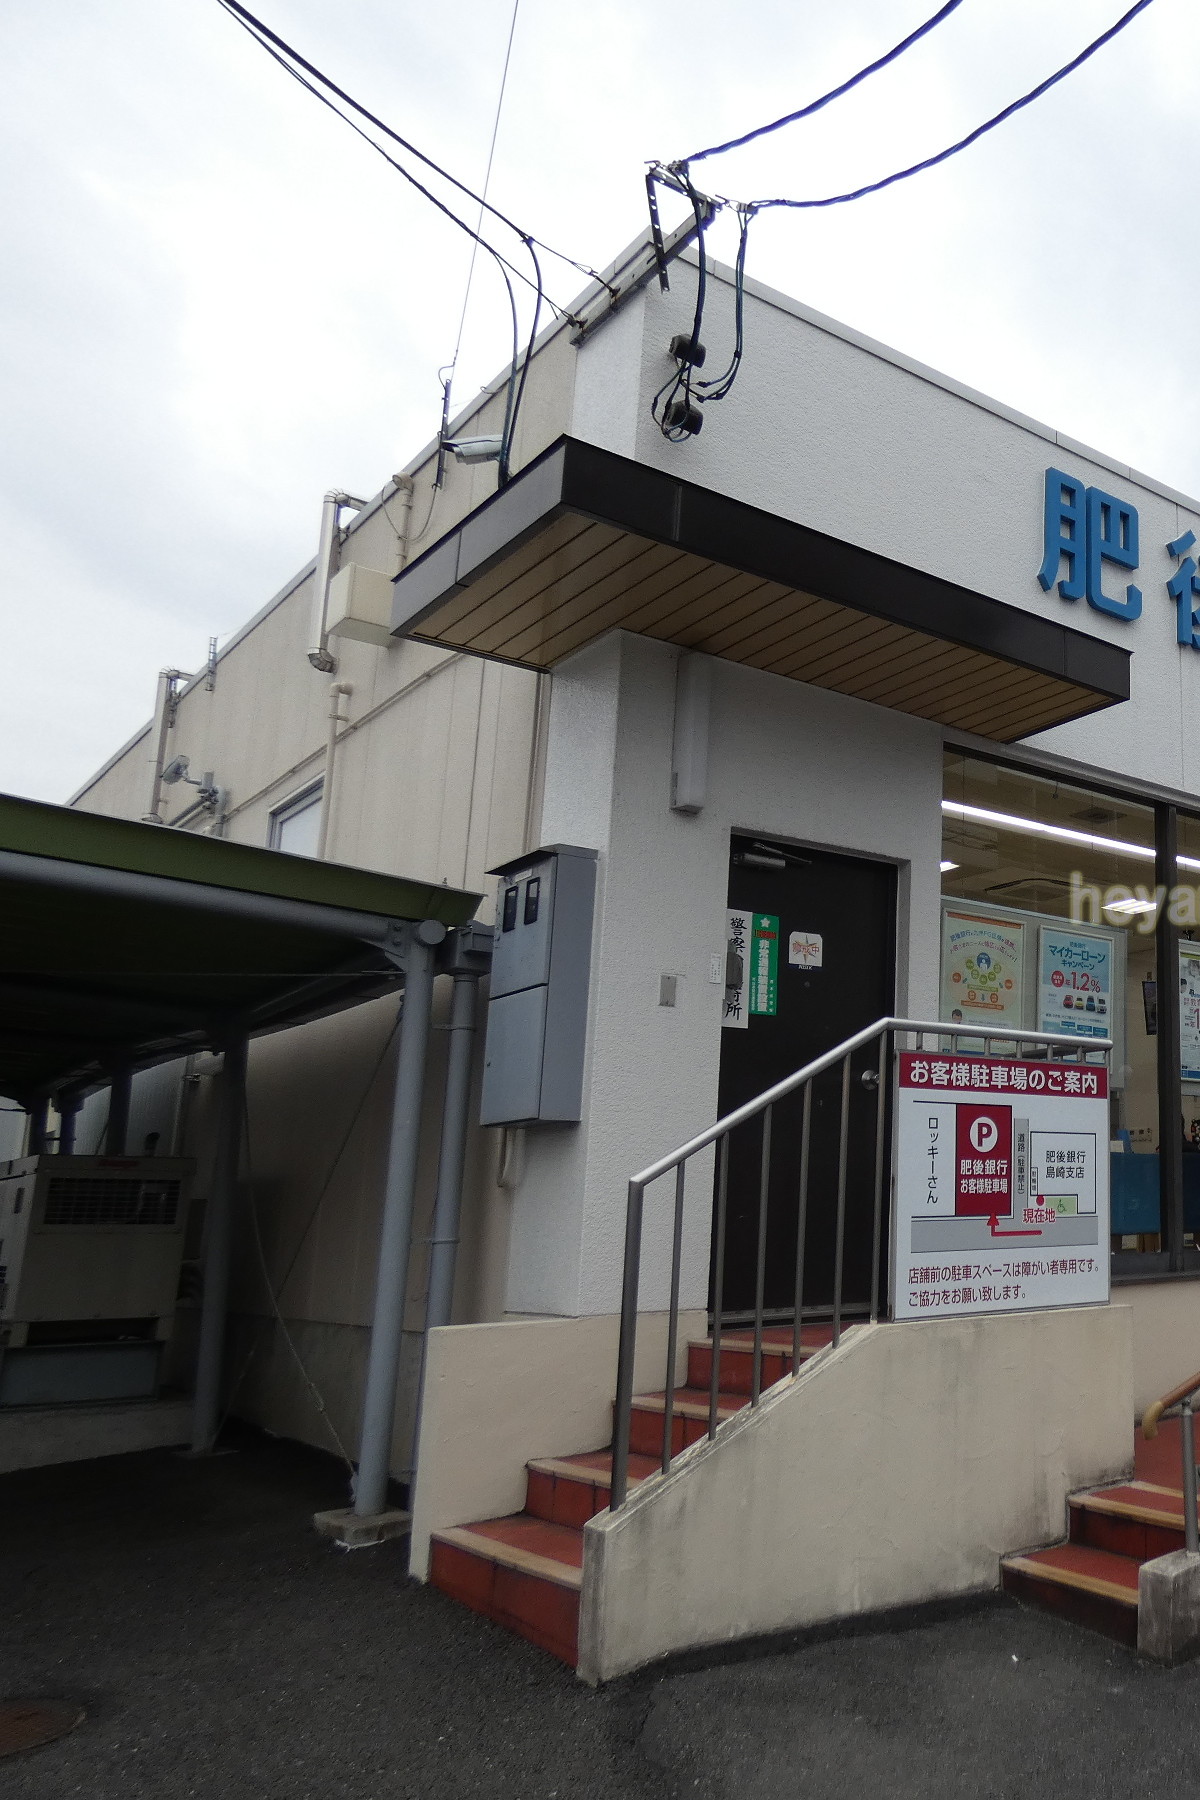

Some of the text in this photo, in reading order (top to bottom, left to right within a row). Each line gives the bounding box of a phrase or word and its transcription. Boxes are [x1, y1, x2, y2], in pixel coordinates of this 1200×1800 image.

[1048, 945, 1106, 964] マイカーローン
[1060, 959, 1095, 971] キャンペーン
[909, 1060, 1099, 1095] お客様駐車場のご案内
[977, 1122, 993, 1147] P
[926, 1117, 939, 1205] ロッキーさん
[1045, 1150, 1087, 1164] 肥後銀行
[960, 1159, 1008, 1177] 肥後銀行
[1045, 1165, 1085, 1180] 島崎支店
[960, 1178, 1008, 1195] お客様駐車場
[1022, 1207, 1056, 1224] 現在地
[908, 1258, 1099, 1284] 店舗前の駐車スペースは障がい者専用です。
[908, 1284, 1026, 1308] ご協力をお願い致します。
